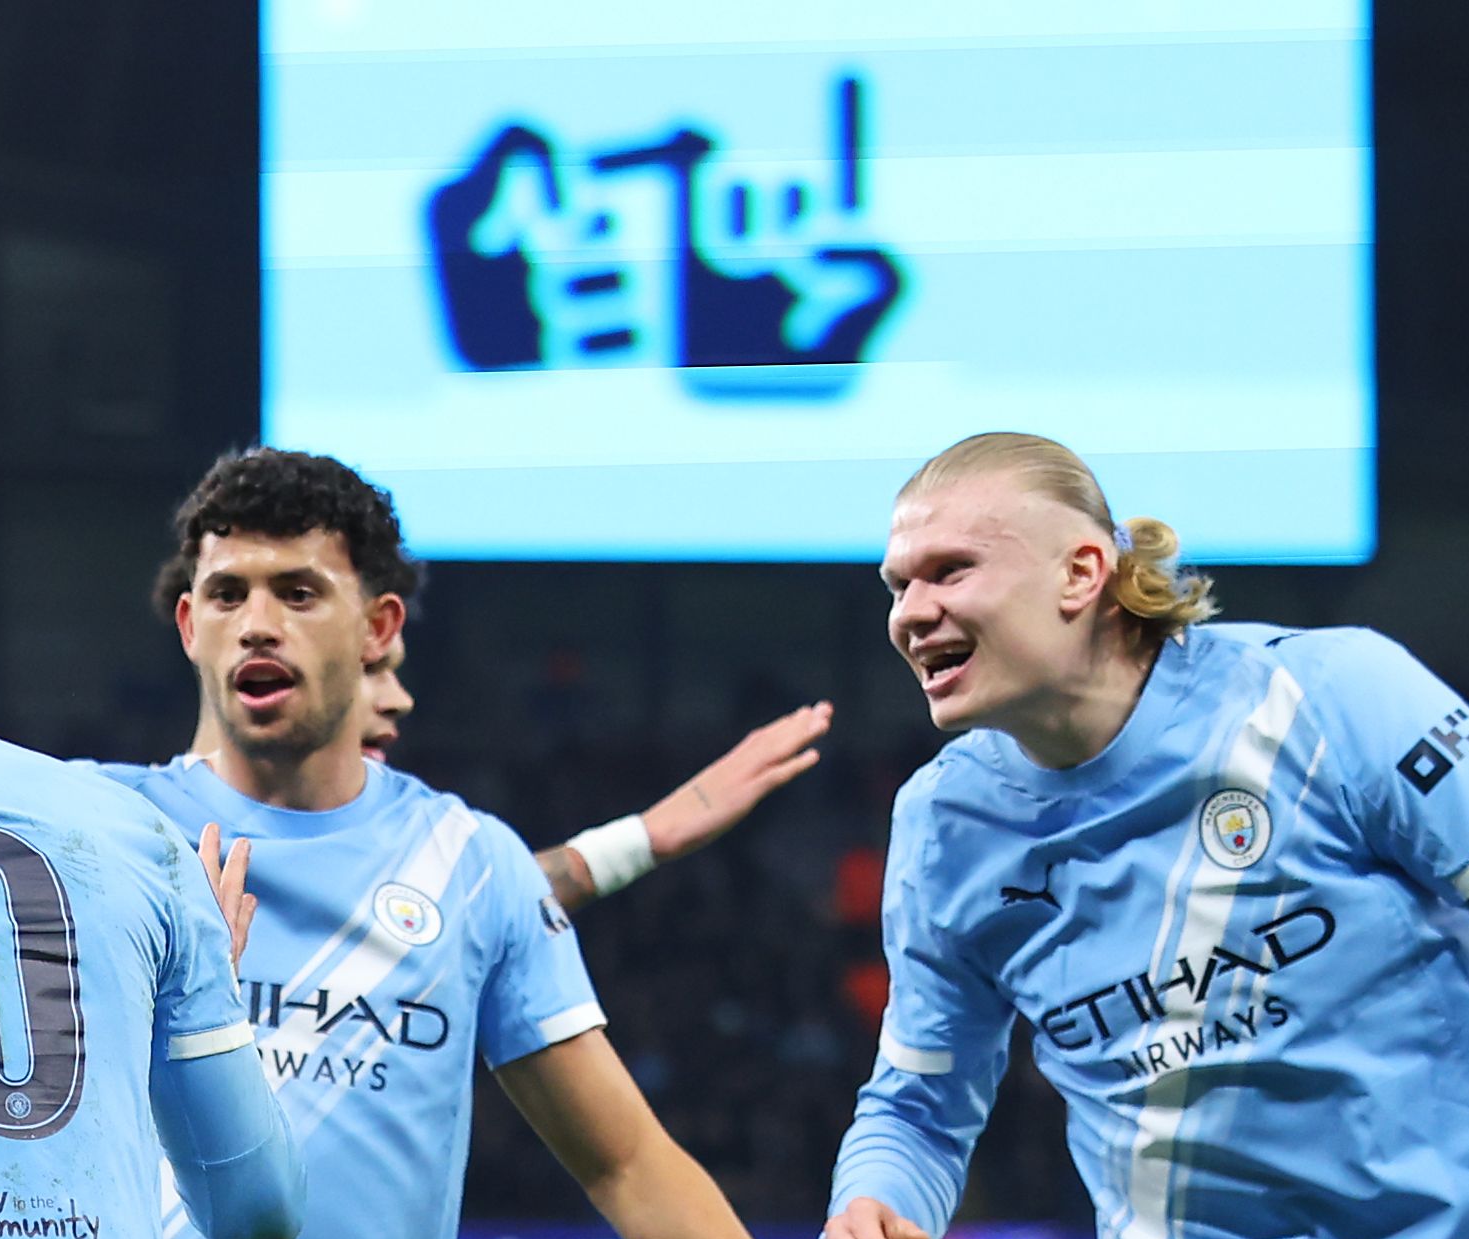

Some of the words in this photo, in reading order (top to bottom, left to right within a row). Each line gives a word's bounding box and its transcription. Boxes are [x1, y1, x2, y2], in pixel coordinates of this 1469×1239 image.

[1040, 906, 1336, 1050] ETIHAD
[238, 979, 449, 1052] IHAD
[258, 1048, 388, 1091] WAYS
[30, 1195, 54, 1210] the
